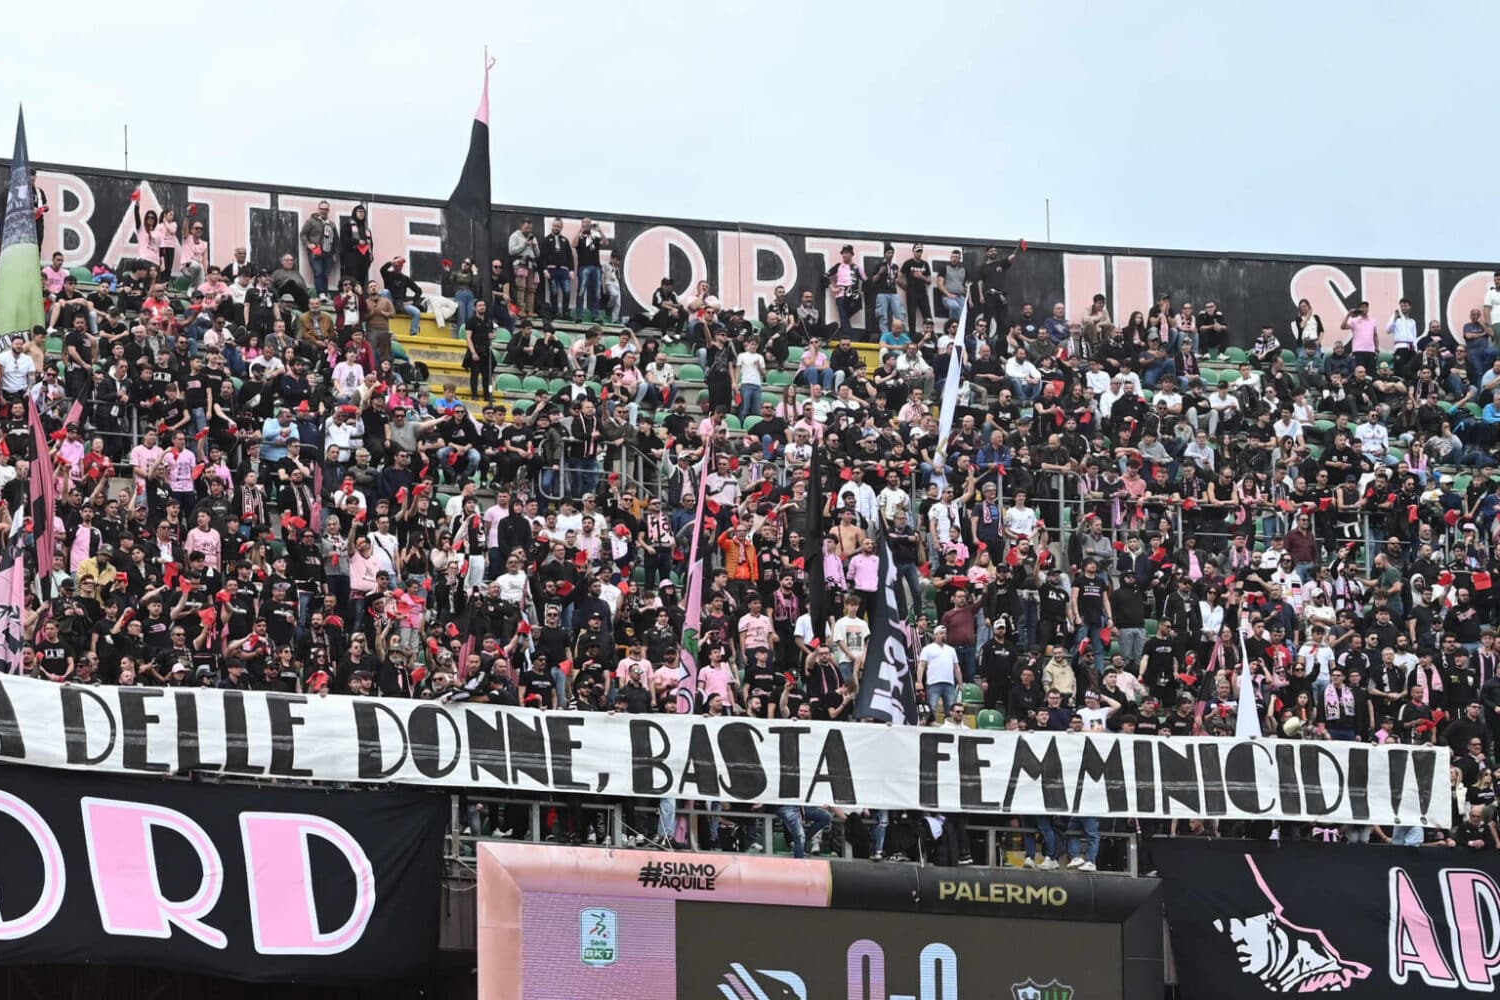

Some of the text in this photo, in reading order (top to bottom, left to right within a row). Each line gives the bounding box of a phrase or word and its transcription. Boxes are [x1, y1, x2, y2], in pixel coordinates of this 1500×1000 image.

[36, 170, 443, 297] BATTE
[62, 686, 315, 778] DELLE
[355, 701, 611, 795] DONNE,
[630, 720, 858, 805] BASTA
[638, 862, 716, 887] #SIAMO
[659, 875, 716, 892] AQUILE
[939, 880, 1068, 906] PALERMO
